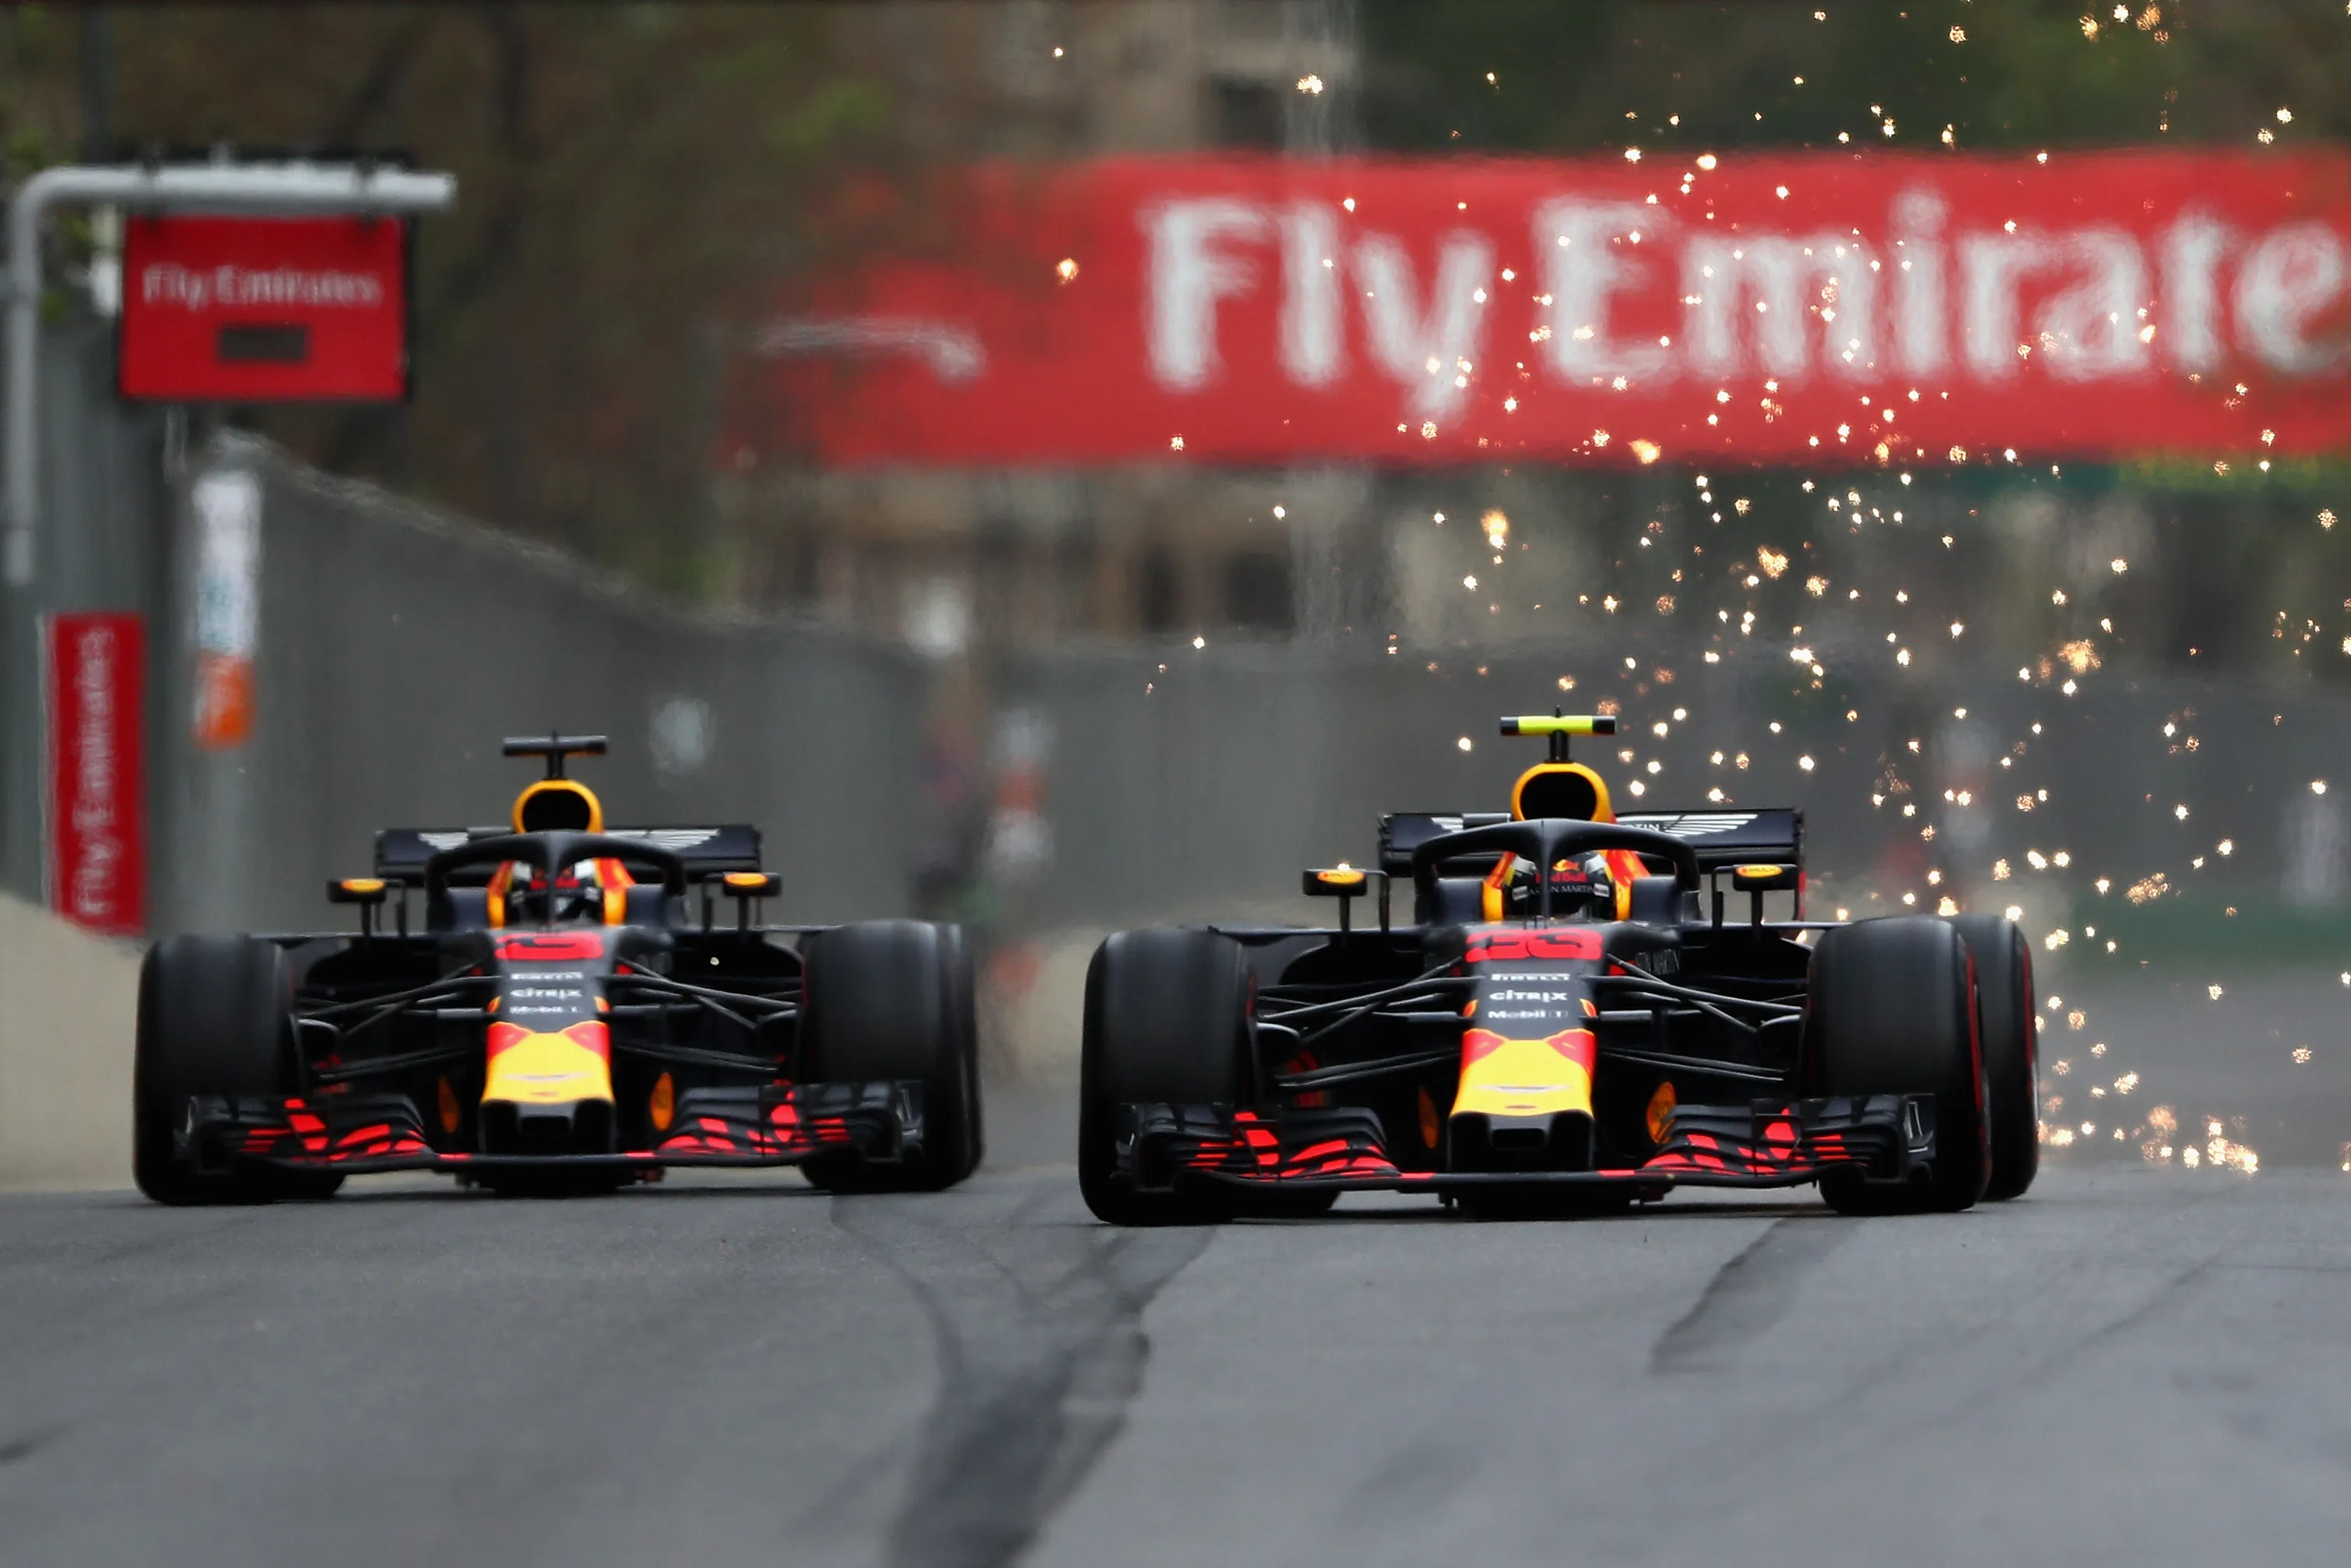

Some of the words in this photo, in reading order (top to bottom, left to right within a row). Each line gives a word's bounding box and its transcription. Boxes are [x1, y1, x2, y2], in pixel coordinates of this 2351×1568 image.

[143, 265, 209, 312] Fly
[215, 263, 384, 304] Emirates
[1140, 196, 1490, 425] Fly
[1488, 1010, 1546, 1019] Mobil
